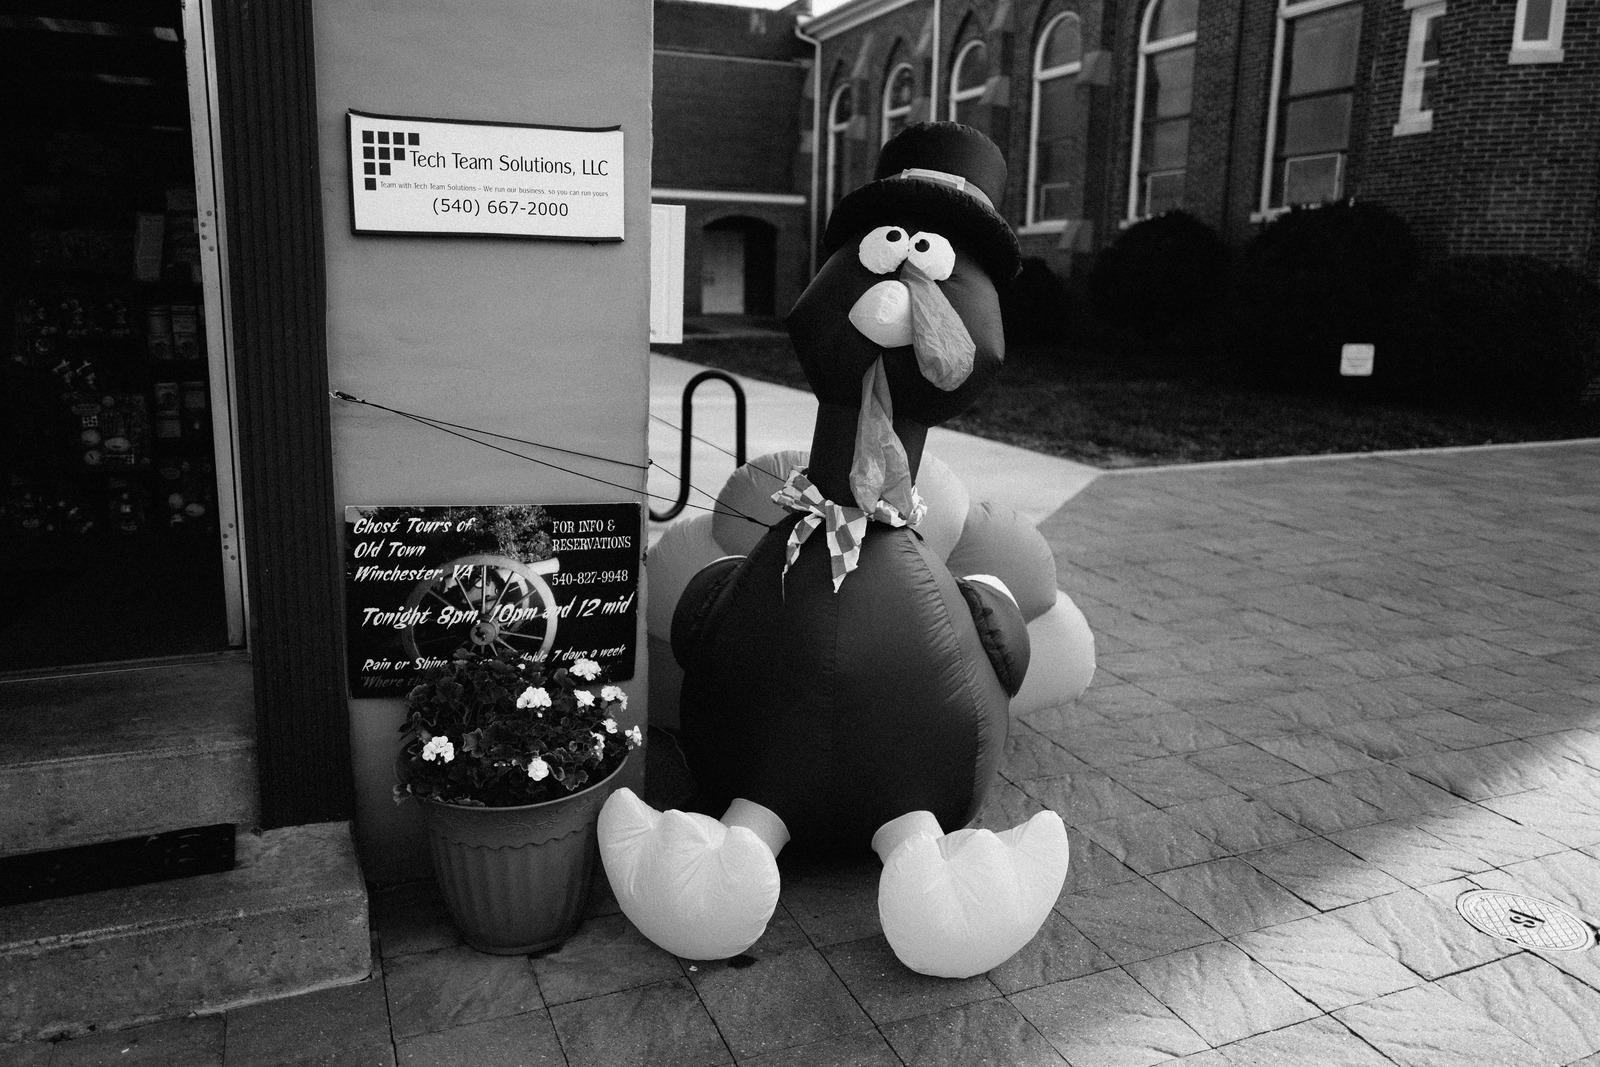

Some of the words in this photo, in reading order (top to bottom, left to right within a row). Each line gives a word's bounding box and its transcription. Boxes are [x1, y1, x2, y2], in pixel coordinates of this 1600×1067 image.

[409, 150, 446, 169] Tech
[451, 152, 493, 170] Team
[499, 154, 576, 176] Solutions,
[582, 159, 609, 176] LLC
[380, 181, 397, 189] Team
[413, 182, 428, 190] Tech
[429, 183, 446, 191] Team
[447, 183, 476, 192] Solutions
[556, 189, 569, 197] you
[592, 190, 609, 198] yours
[433, 197, 480, 217] (540)
[487, 200, 569, 217] 667-2000
[353, 516, 401, 535] Ghost
[406, 517, 453, 534] Tours
[456, 517, 476, 533] of
[552, 520, 576, 534] FOR
[578, 519, 604, 533] INFO
[607, 519, 616, 532] &
[353, 538, 386, 559] Old
[388, 541, 426, 558] Town
[552, 535, 631, 552] RESERVATIONS
[353, 564, 444, 583] Winchester,
[451, 564, 475, 581] VA
[551, 569, 629, 586] 540-827-9948
[361, 604, 433, 630] Tonight
[436, 605, 481, 630] 8pm,
[488, 603, 538, 628] 10pm
[541, 595, 577, 619] and
[576, 598, 602, 618] 12
[601, 590, 635, 616] mid
[551, 649, 563, 662] 7
[590, 649, 598, 658] a
[599, 643, 627, 658] week
[361, 657, 392, 672] Rain
[394, 660, 411, 671] or
